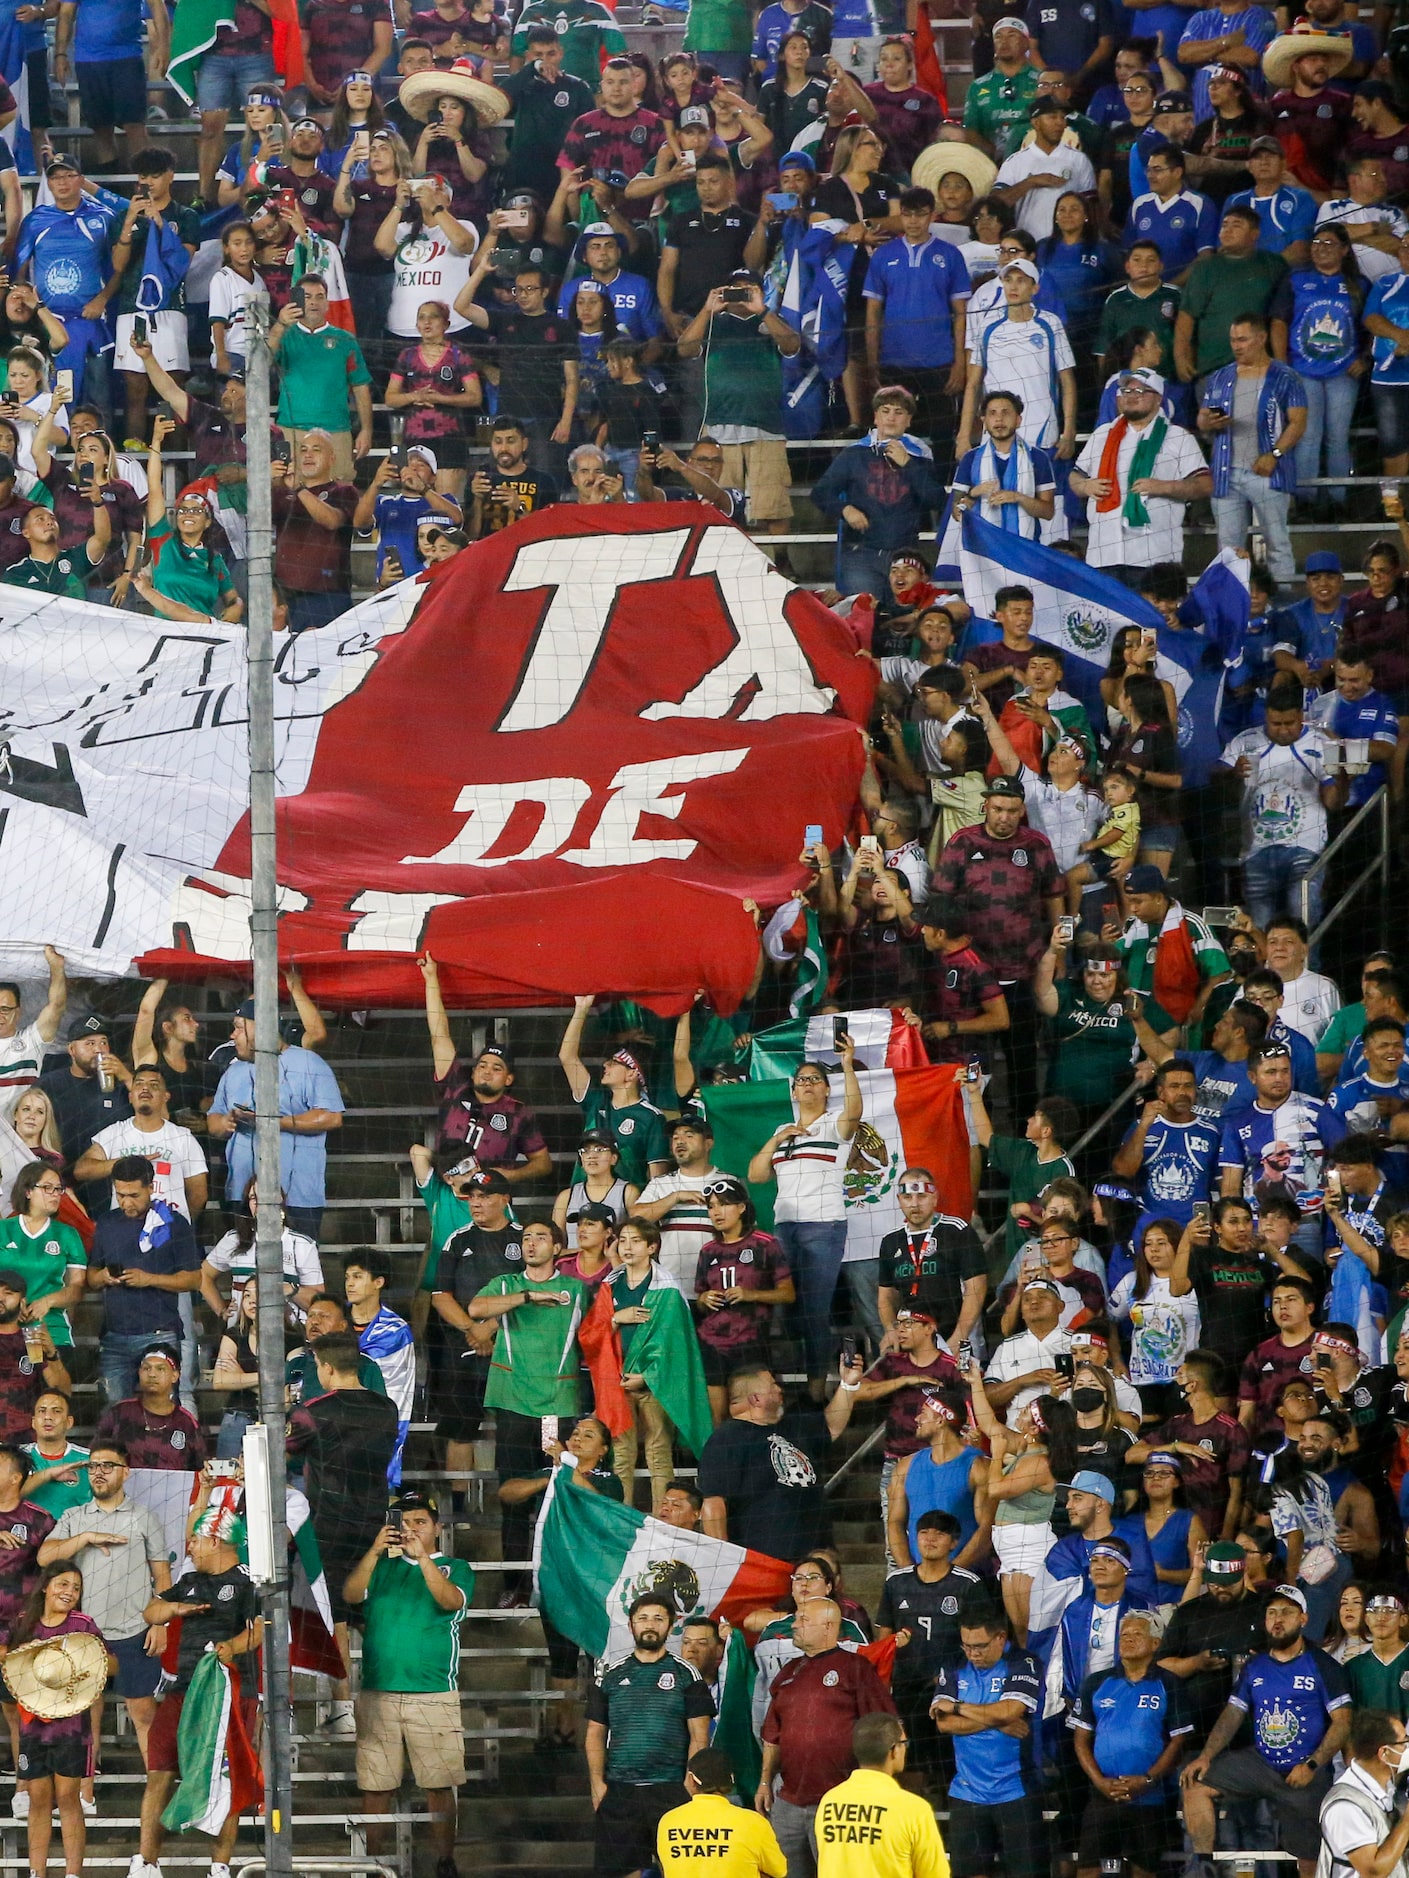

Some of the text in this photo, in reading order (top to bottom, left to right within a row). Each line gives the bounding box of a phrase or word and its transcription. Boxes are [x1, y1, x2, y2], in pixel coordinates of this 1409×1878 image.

[1039, 9, 1057, 24] ES
[725, 217, 741, 228] ES
[1081, 255, 1097, 268] ES
[396, 267, 441, 287] MÉXICO
[614, 293, 636, 309] ES
[399, 746, 752, 869] DE
[1068, 1008, 1119, 1029] MÉXICO
[465, 1120, 484, 1151] 11
[1238, 1125, 1252, 1140] ES
[1190, 1136, 1209, 1152] ES
[719, 1266, 736, 1290] 11
[917, 1616, 932, 1641] 9
[1292, 1674, 1315, 1692] ES
[1137, 1694, 1161, 1711] ES
[823, 1802, 888, 1825] EVENT
[666, 1827, 734, 1843] EVENT
[822, 1824, 883, 1846] STAFF
[668, 1845, 730, 1860] STAFF
